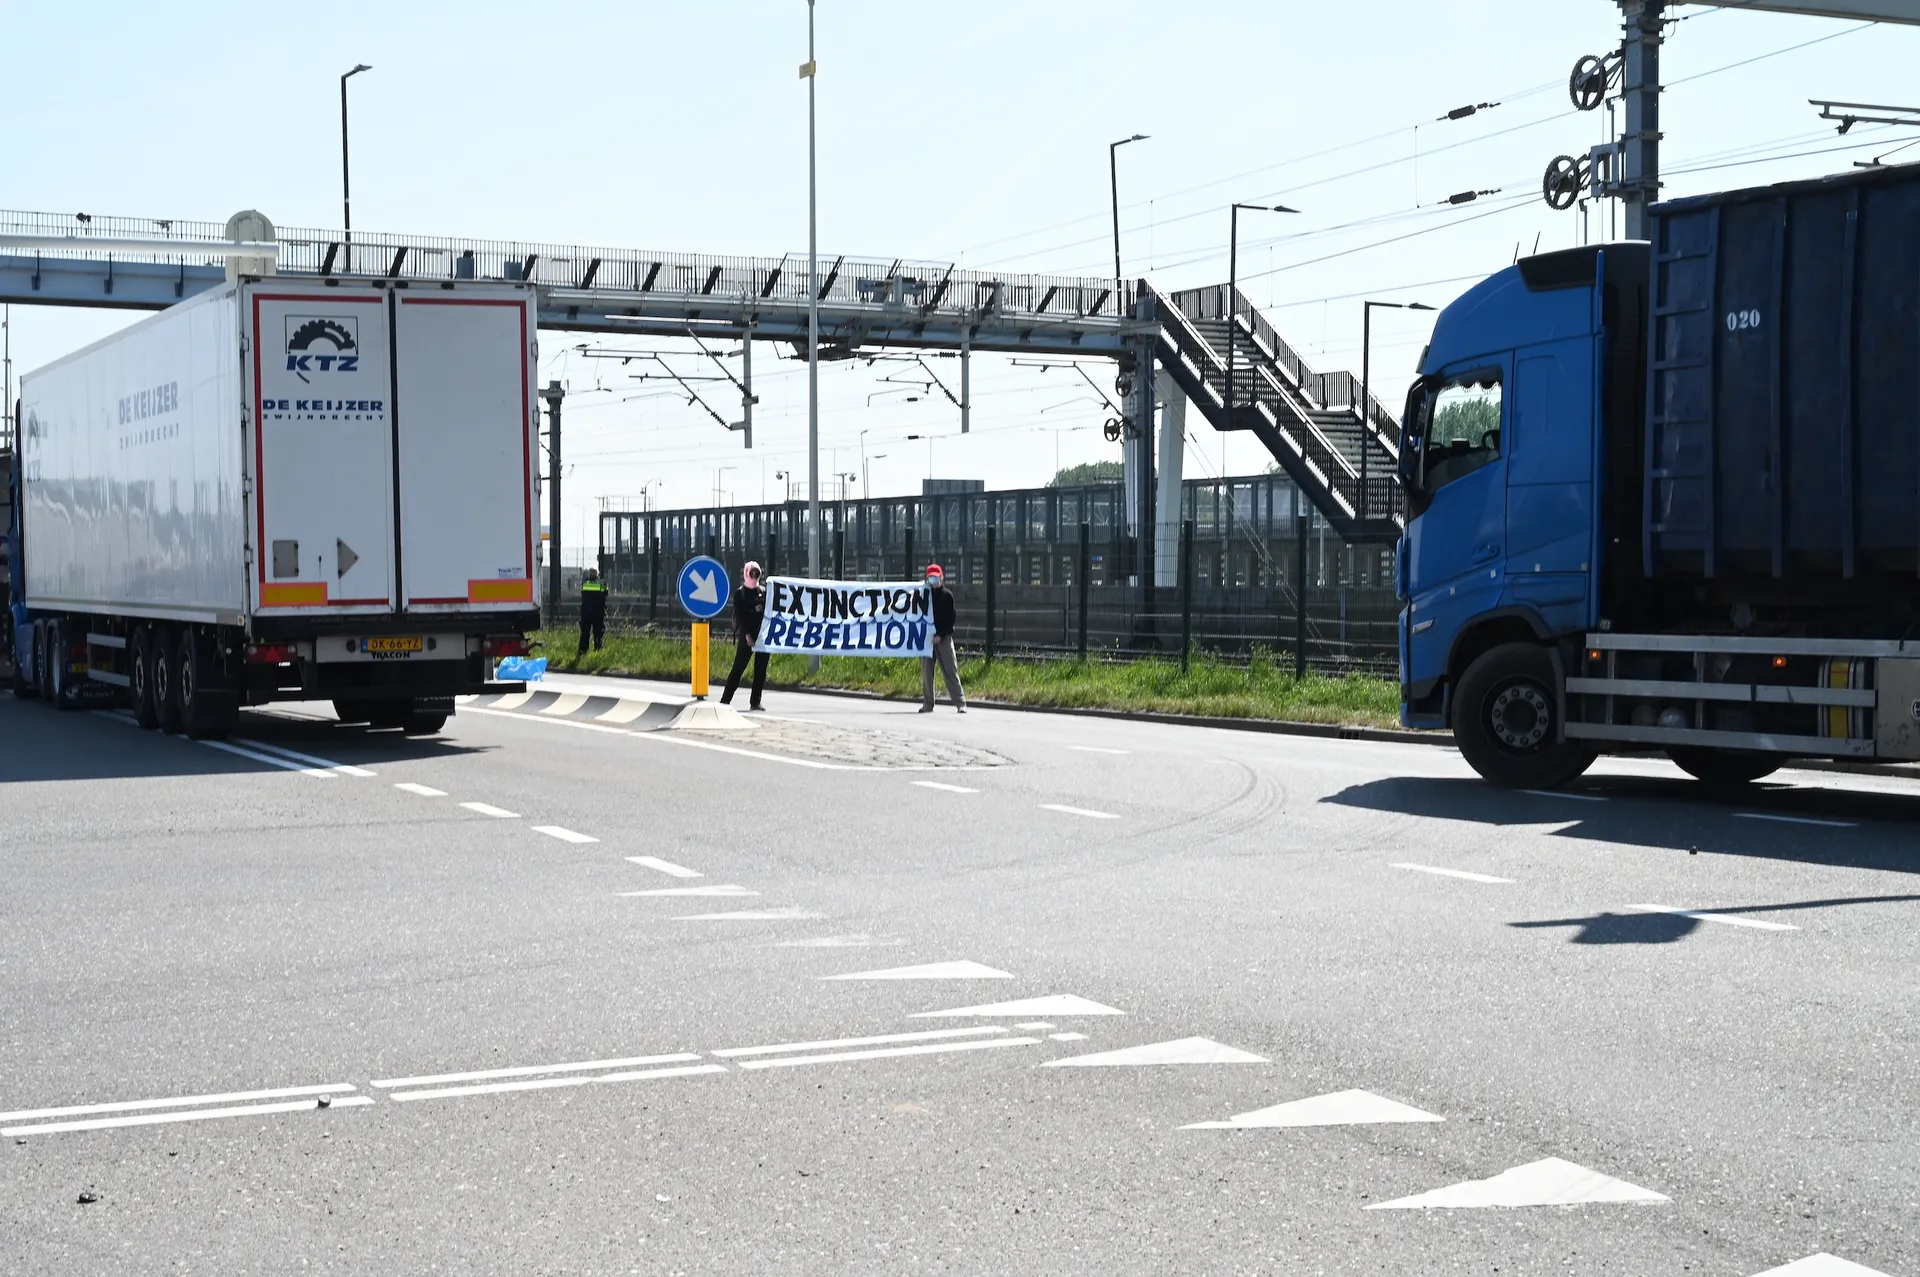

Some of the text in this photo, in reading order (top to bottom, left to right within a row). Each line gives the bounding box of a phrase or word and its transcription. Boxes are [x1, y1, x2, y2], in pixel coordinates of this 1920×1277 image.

[1727, 309, 1760, 331] 020
[287, 355, 358, 371] KTZ
[119, 381, 178, 425] DE KEIJZER
[263, 400, 383, 411] DE KEIJZER
[772, 582, 930, 619] EXTINCTION
[371, 639, 419, 649] OK-66-YZ
[764, 617, 927, 650] REBELLION
